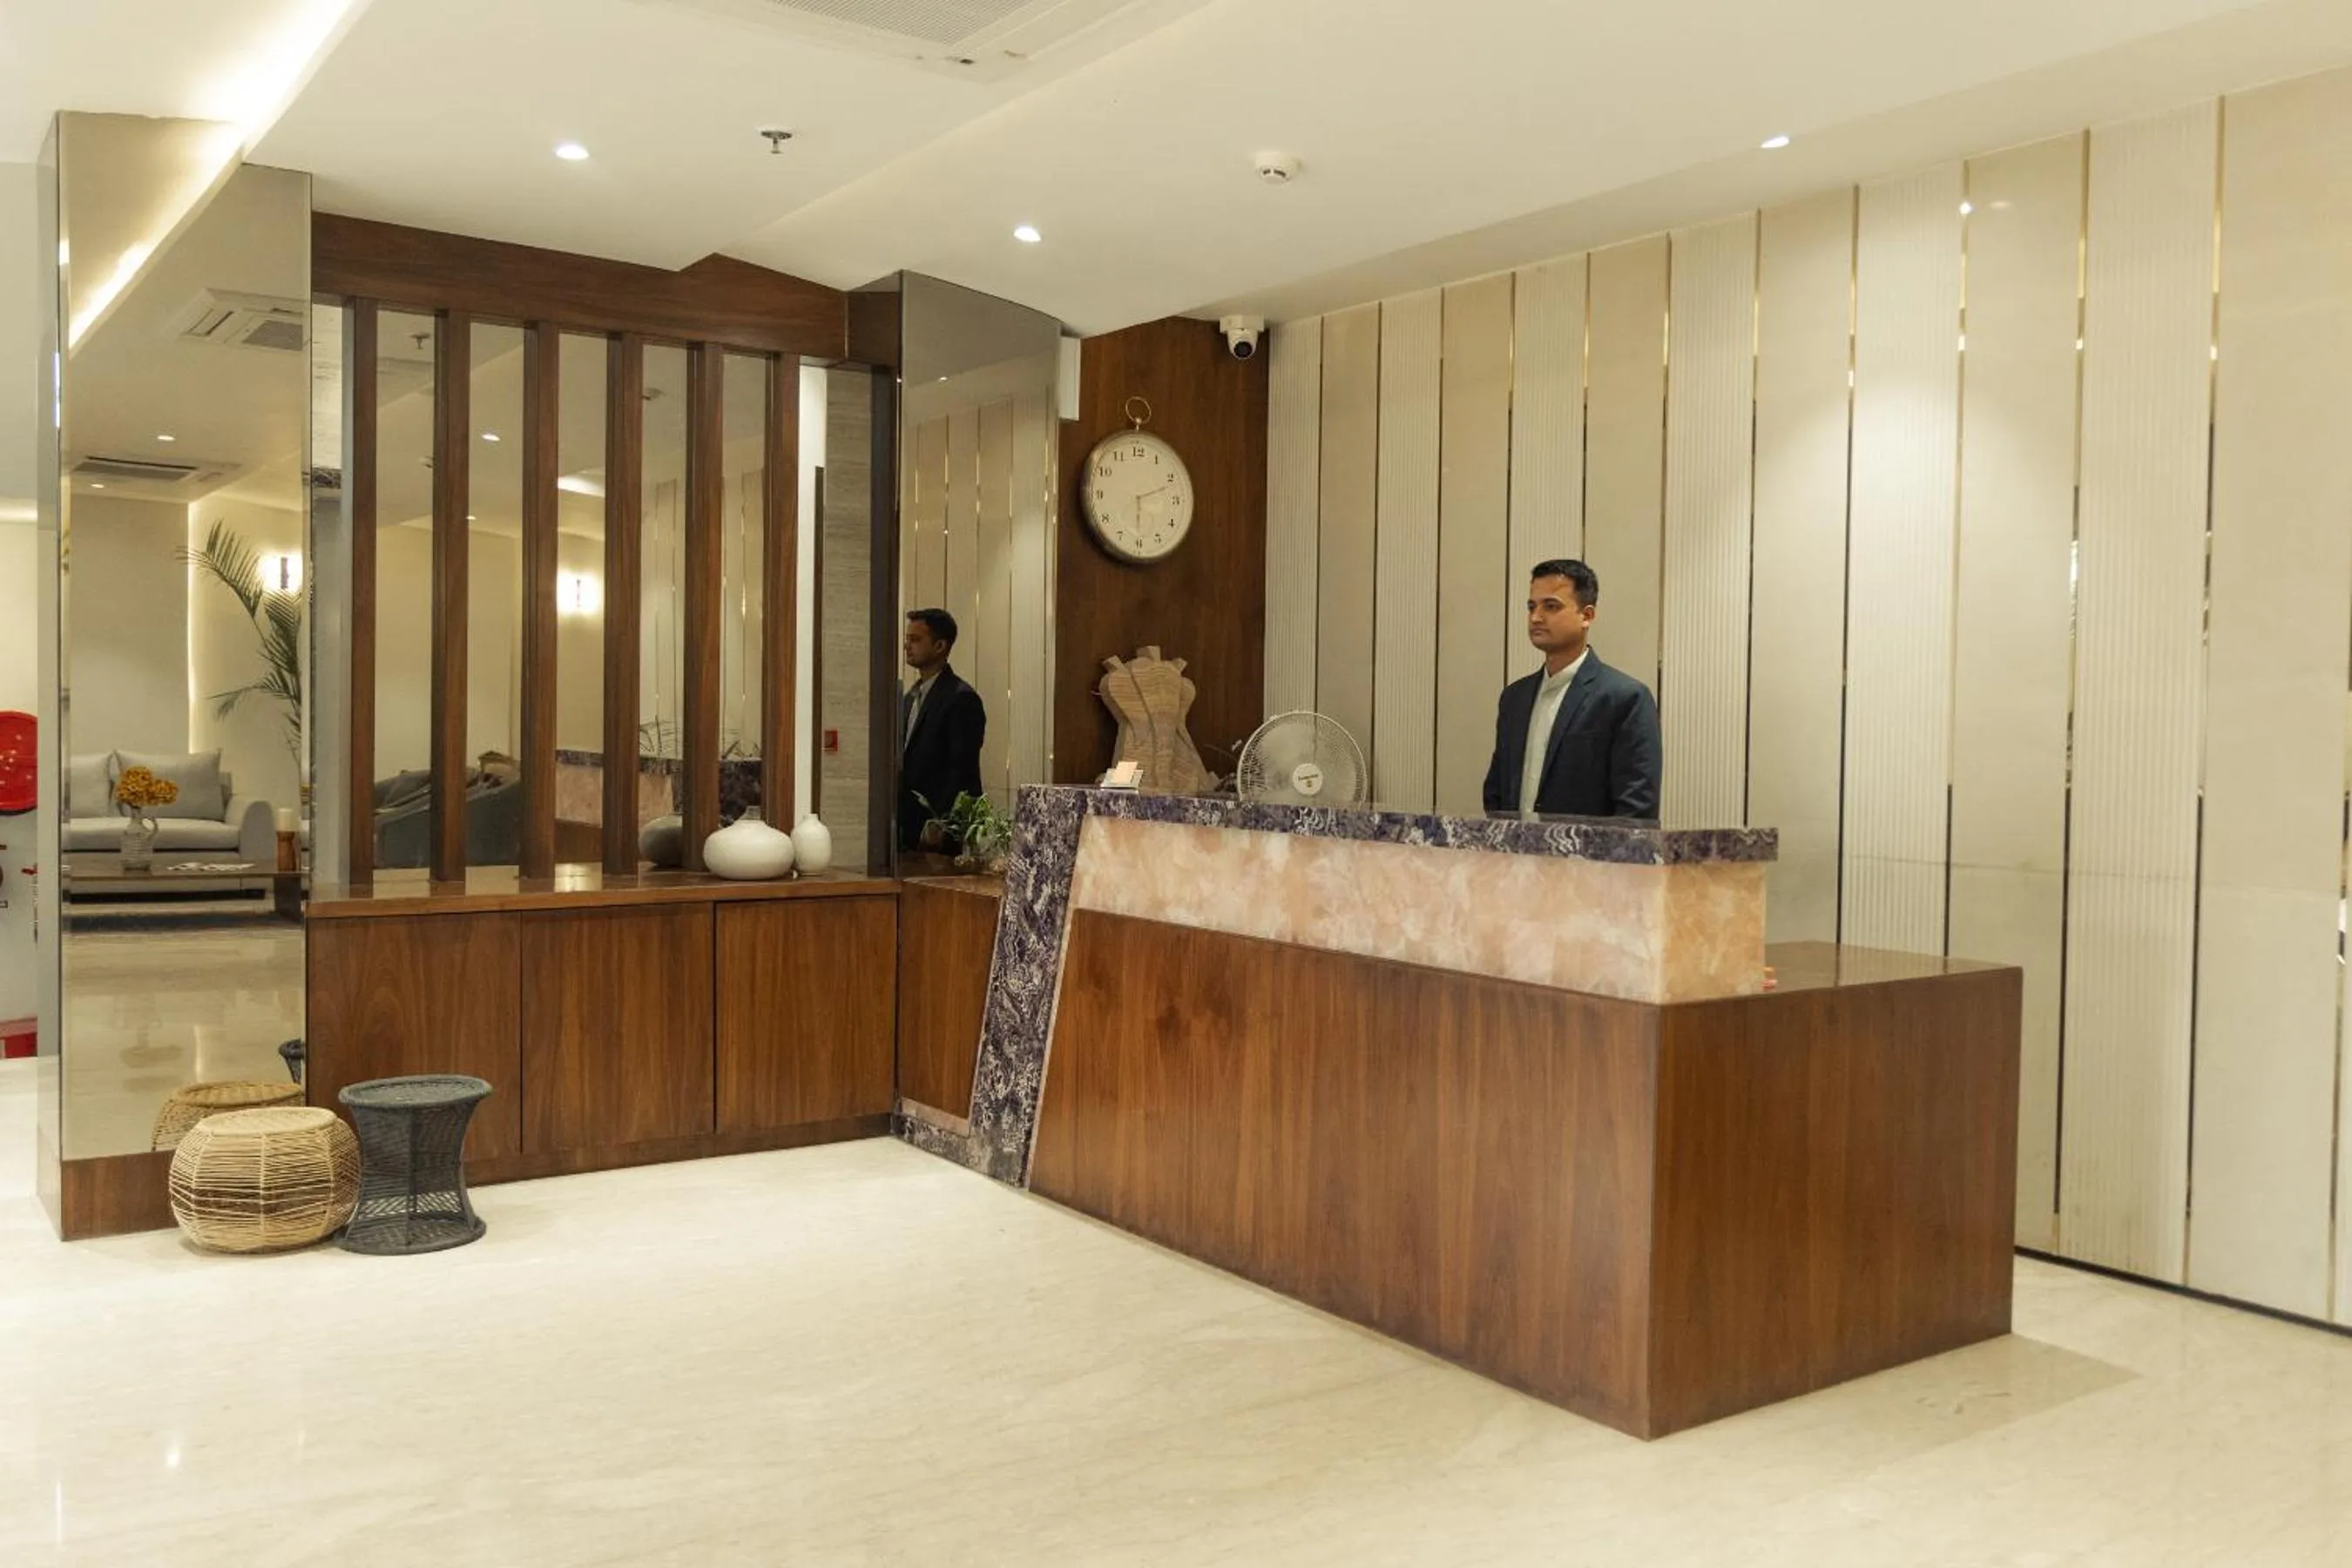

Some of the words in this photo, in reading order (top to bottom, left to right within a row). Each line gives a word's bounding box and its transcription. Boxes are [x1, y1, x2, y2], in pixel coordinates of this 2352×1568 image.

[1113, 450, 1124, 462] 11
[1132, 447, 1145, 457] 12
[1154, 454, 1159, 464] 1
[1098, 466, 1112, 476] 10
[1167, 473, 1173, 483] 2
[1096, 490, 1104, 499] 9
[1173, 496, 1179, 505] 3
[1101, 514, 1109, 524] 8
[1168, 518, 1174, 528] 4
[1117, 531, 1123, 540] 7
[1154, 533, 1161, 544] 5
[1135, 538, 1143, 549] 6
